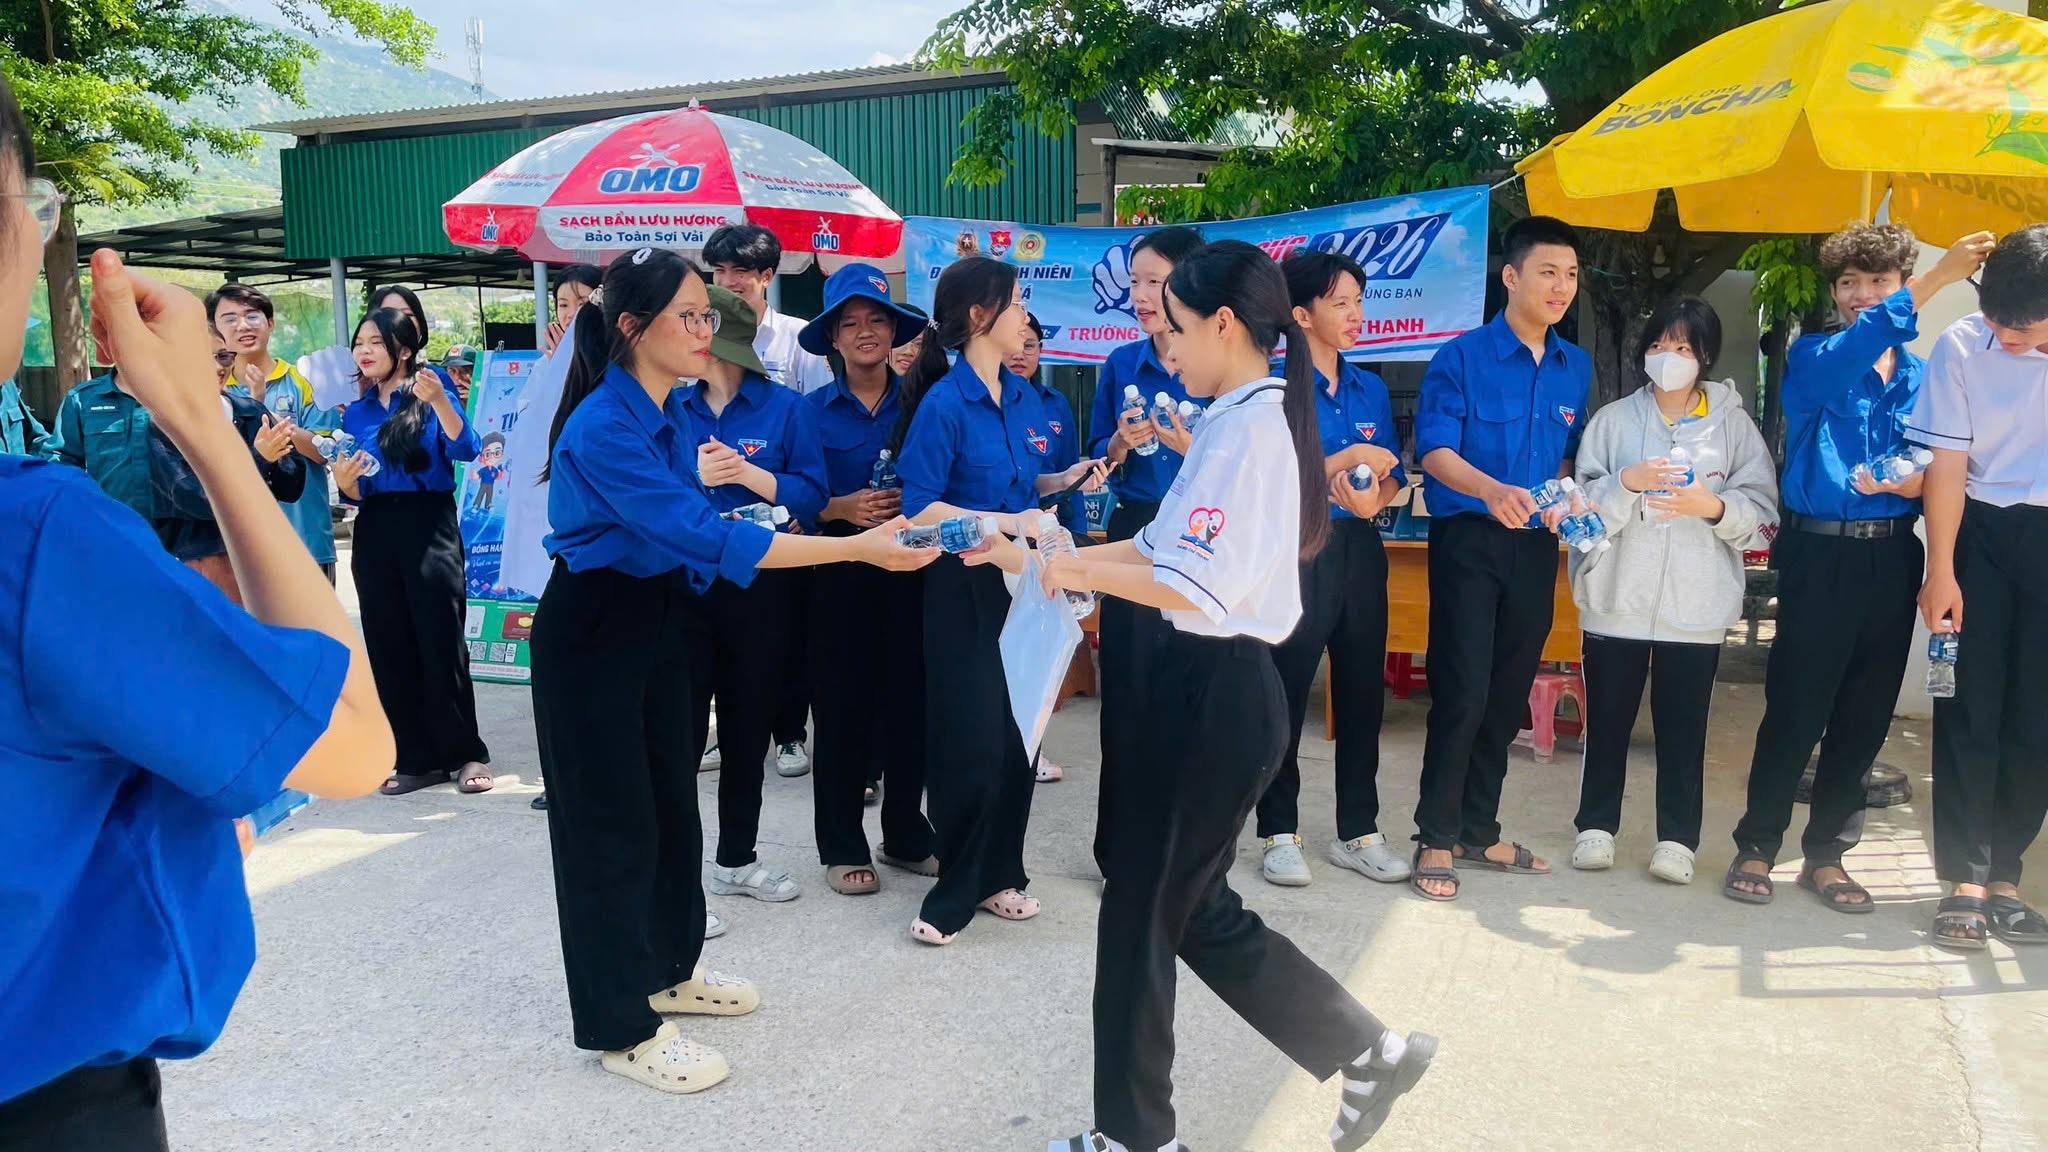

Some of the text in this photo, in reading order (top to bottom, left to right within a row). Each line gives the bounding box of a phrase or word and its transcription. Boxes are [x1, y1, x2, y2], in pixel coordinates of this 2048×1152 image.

[1591, 78, 1793, 136] BONCHA
[599, 165, 701, 193] OMO
[560, 211, 727, 229] SẠCH BẨN LƯU HƯƠNG
[585, 229, 703, 244] Bảo Toàn Sợi Vải
[813, 233, 839, 250] OMO
[1318, 215, 1440, 277] 2026
[1033, 264, 1072, 279] NIÊN
[1364, 286, 1423, 300] ÙNG BẠN
[1068, 323, 1140, 341] TRƯỜNG
